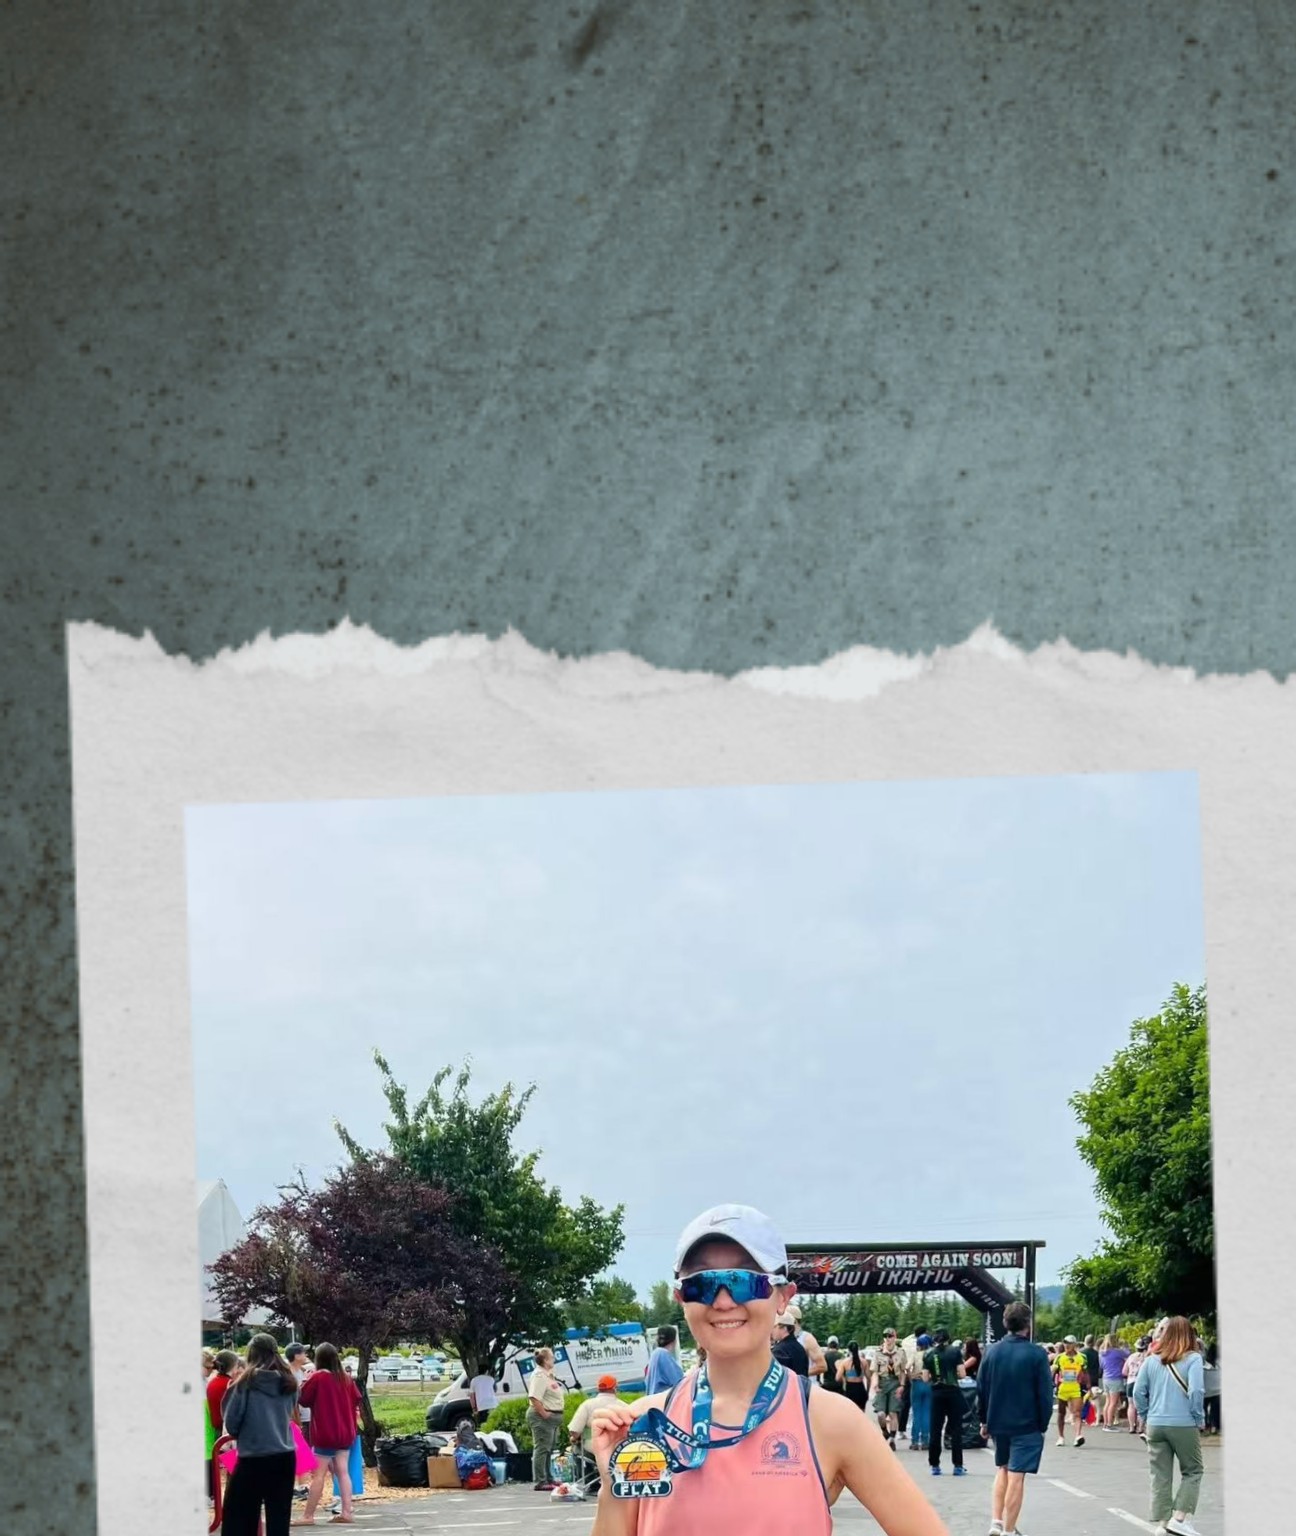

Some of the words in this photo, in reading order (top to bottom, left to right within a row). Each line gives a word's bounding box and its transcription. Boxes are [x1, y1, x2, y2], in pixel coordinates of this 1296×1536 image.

[876, 1254, 919, 1269] COME
[921, 1253, 970, 1268] AGAIN
[972, 1251, 1017, 1267] SOON!
[822, 1271, 871, 1287] FOOT
[877, 1269, 954, 1286] TRAFFIC
[764, 1359, 783, 1392] FULL
[620, 1483, 661, 1496] FLAT
